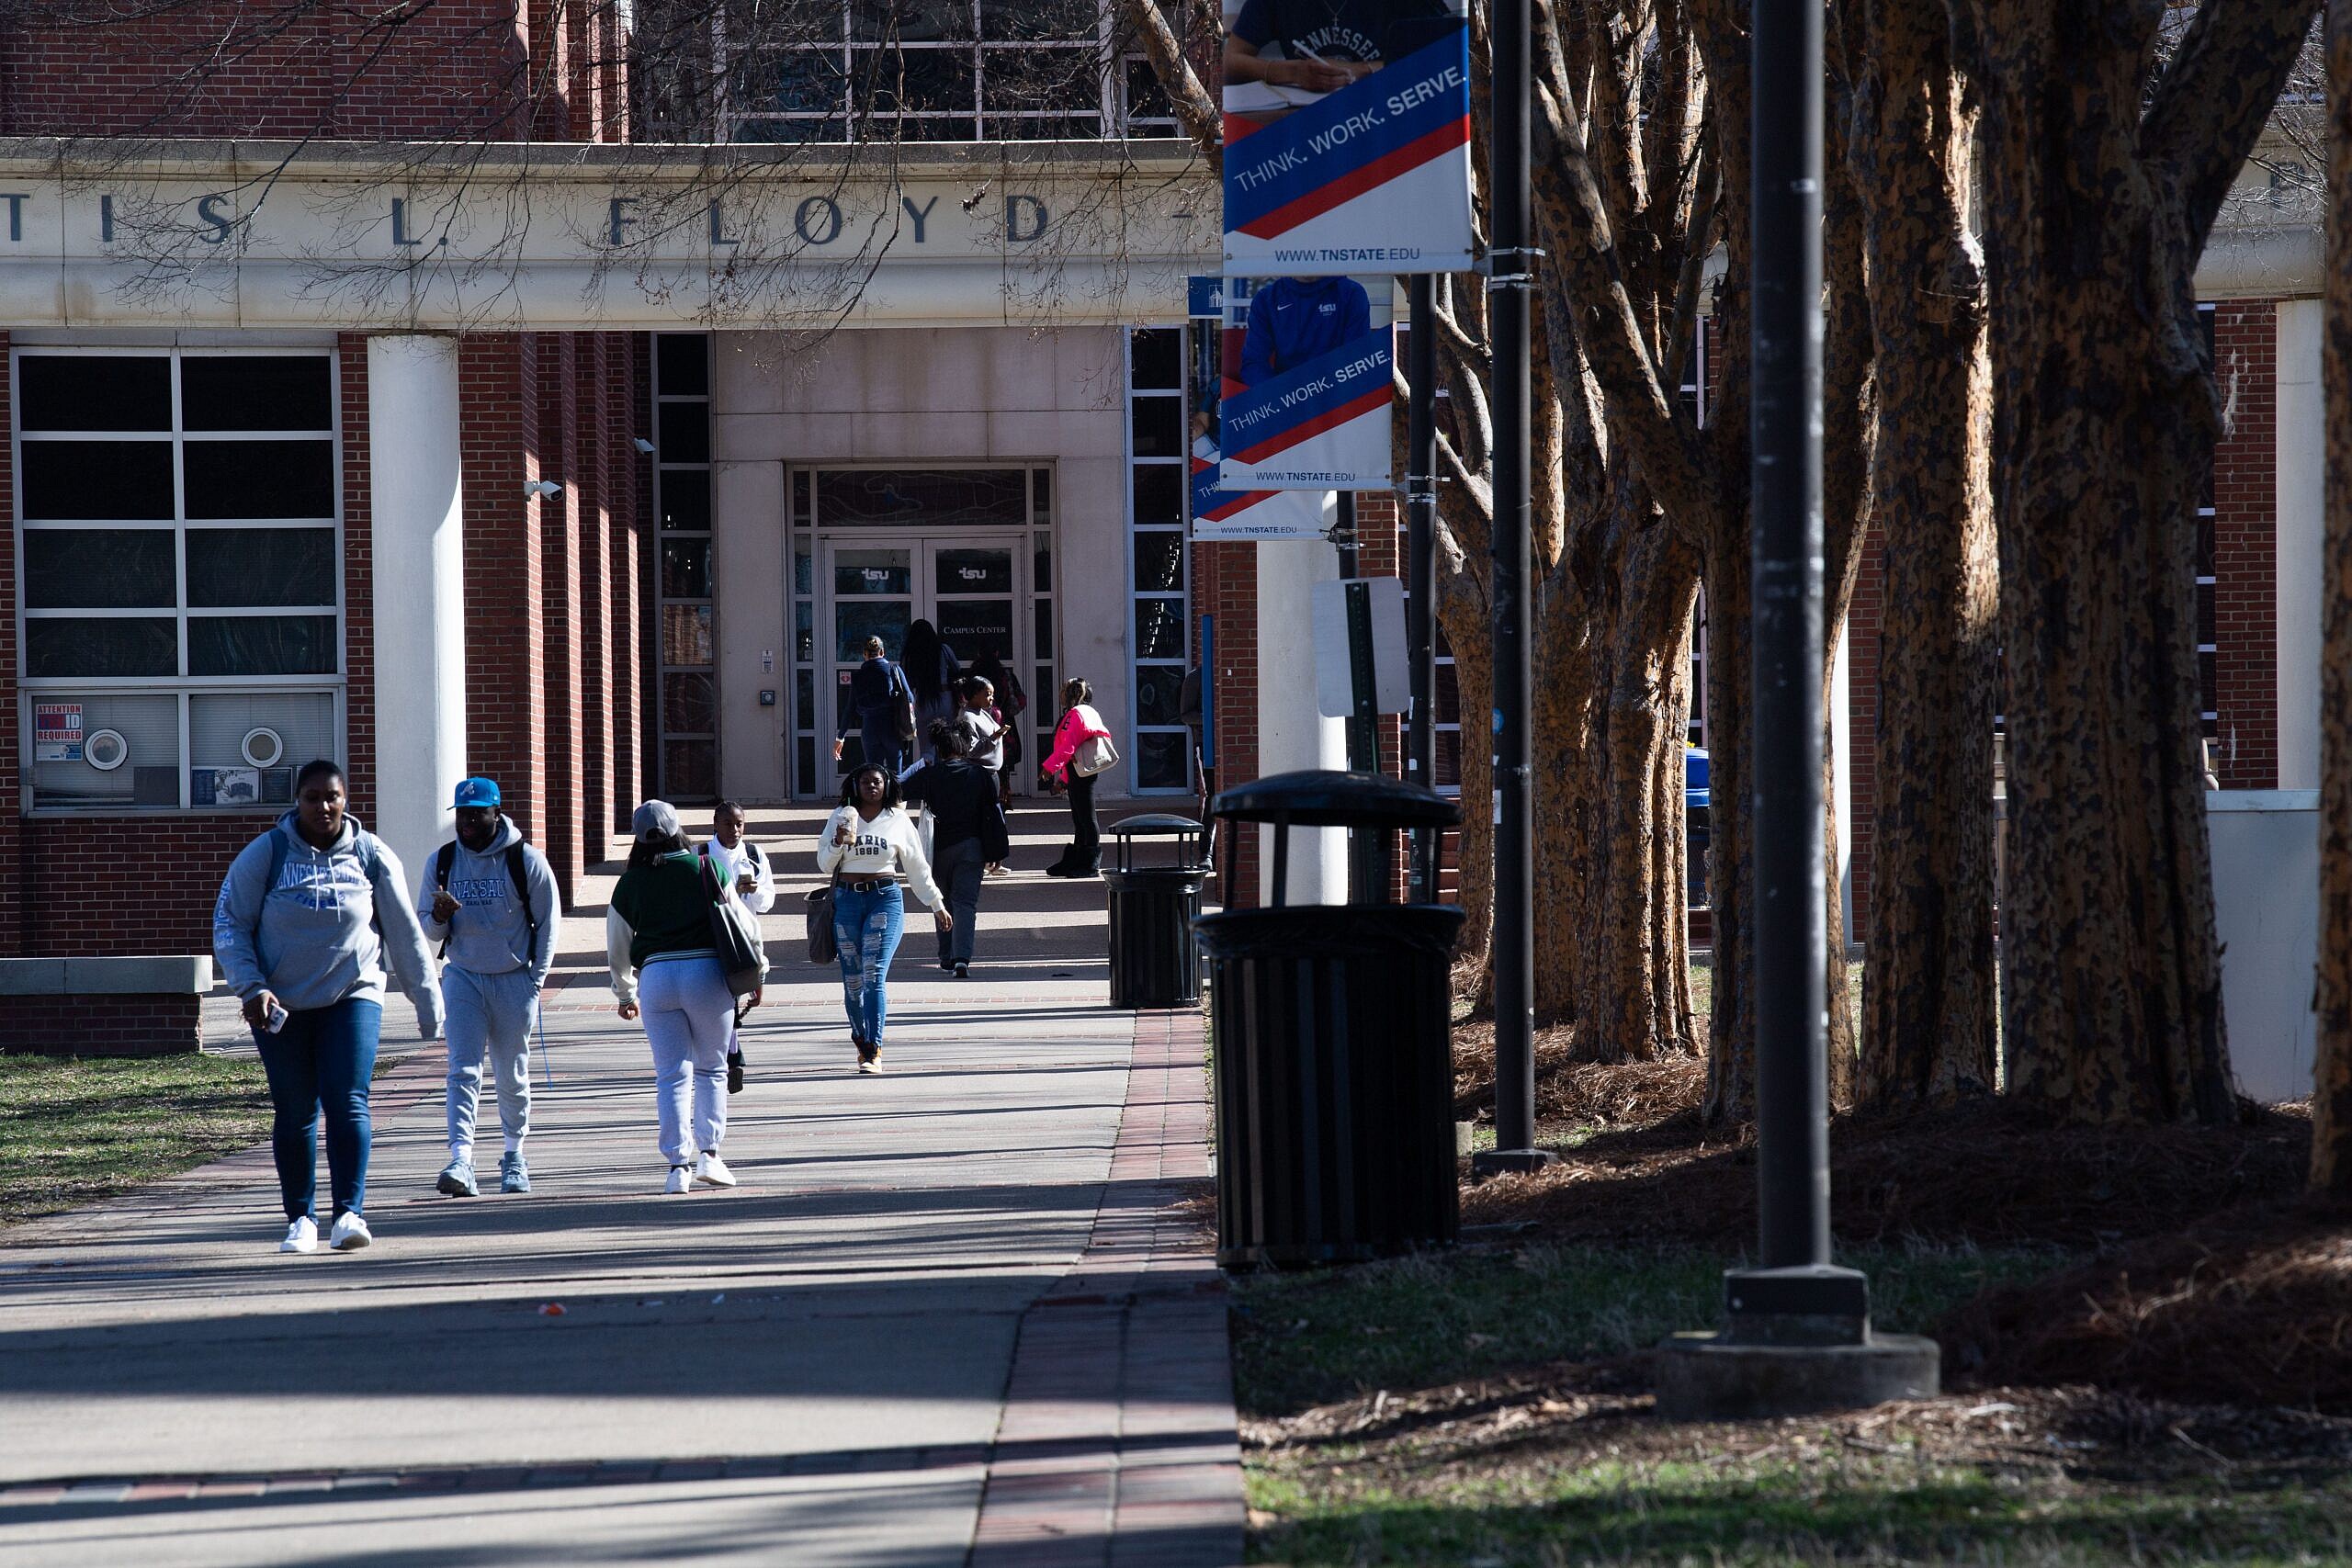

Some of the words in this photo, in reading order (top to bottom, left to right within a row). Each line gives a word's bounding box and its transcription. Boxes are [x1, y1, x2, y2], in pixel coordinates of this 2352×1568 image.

[1234, 148, 1308, 192] THINK.
[1308, 107, 1385, 156] WORK.
[1386, 66, 1467, 117] SERVE.
[608, 194, 1048, 247] FLOYD
[1275, 247, 1421, 263] WWW.TNSTATE.EDU
[1228, 401, 1281, 433] THINK.
[1281, 376, 1334, 409] WORK.
[1335, 349, 1392, 383] SERVE.
[1255, 471, 1356, 482] WWW.TNSTATE.EDU
[1220, 525, 1297, 535] WWW.TNSTATE.EDU
[38, 705, 81, 714] ATTENTION
[65, 714, 80, 729] ID
[38, 730, 82, 740] REQUIRED
[451, 878, 506, 899] NASSAU
